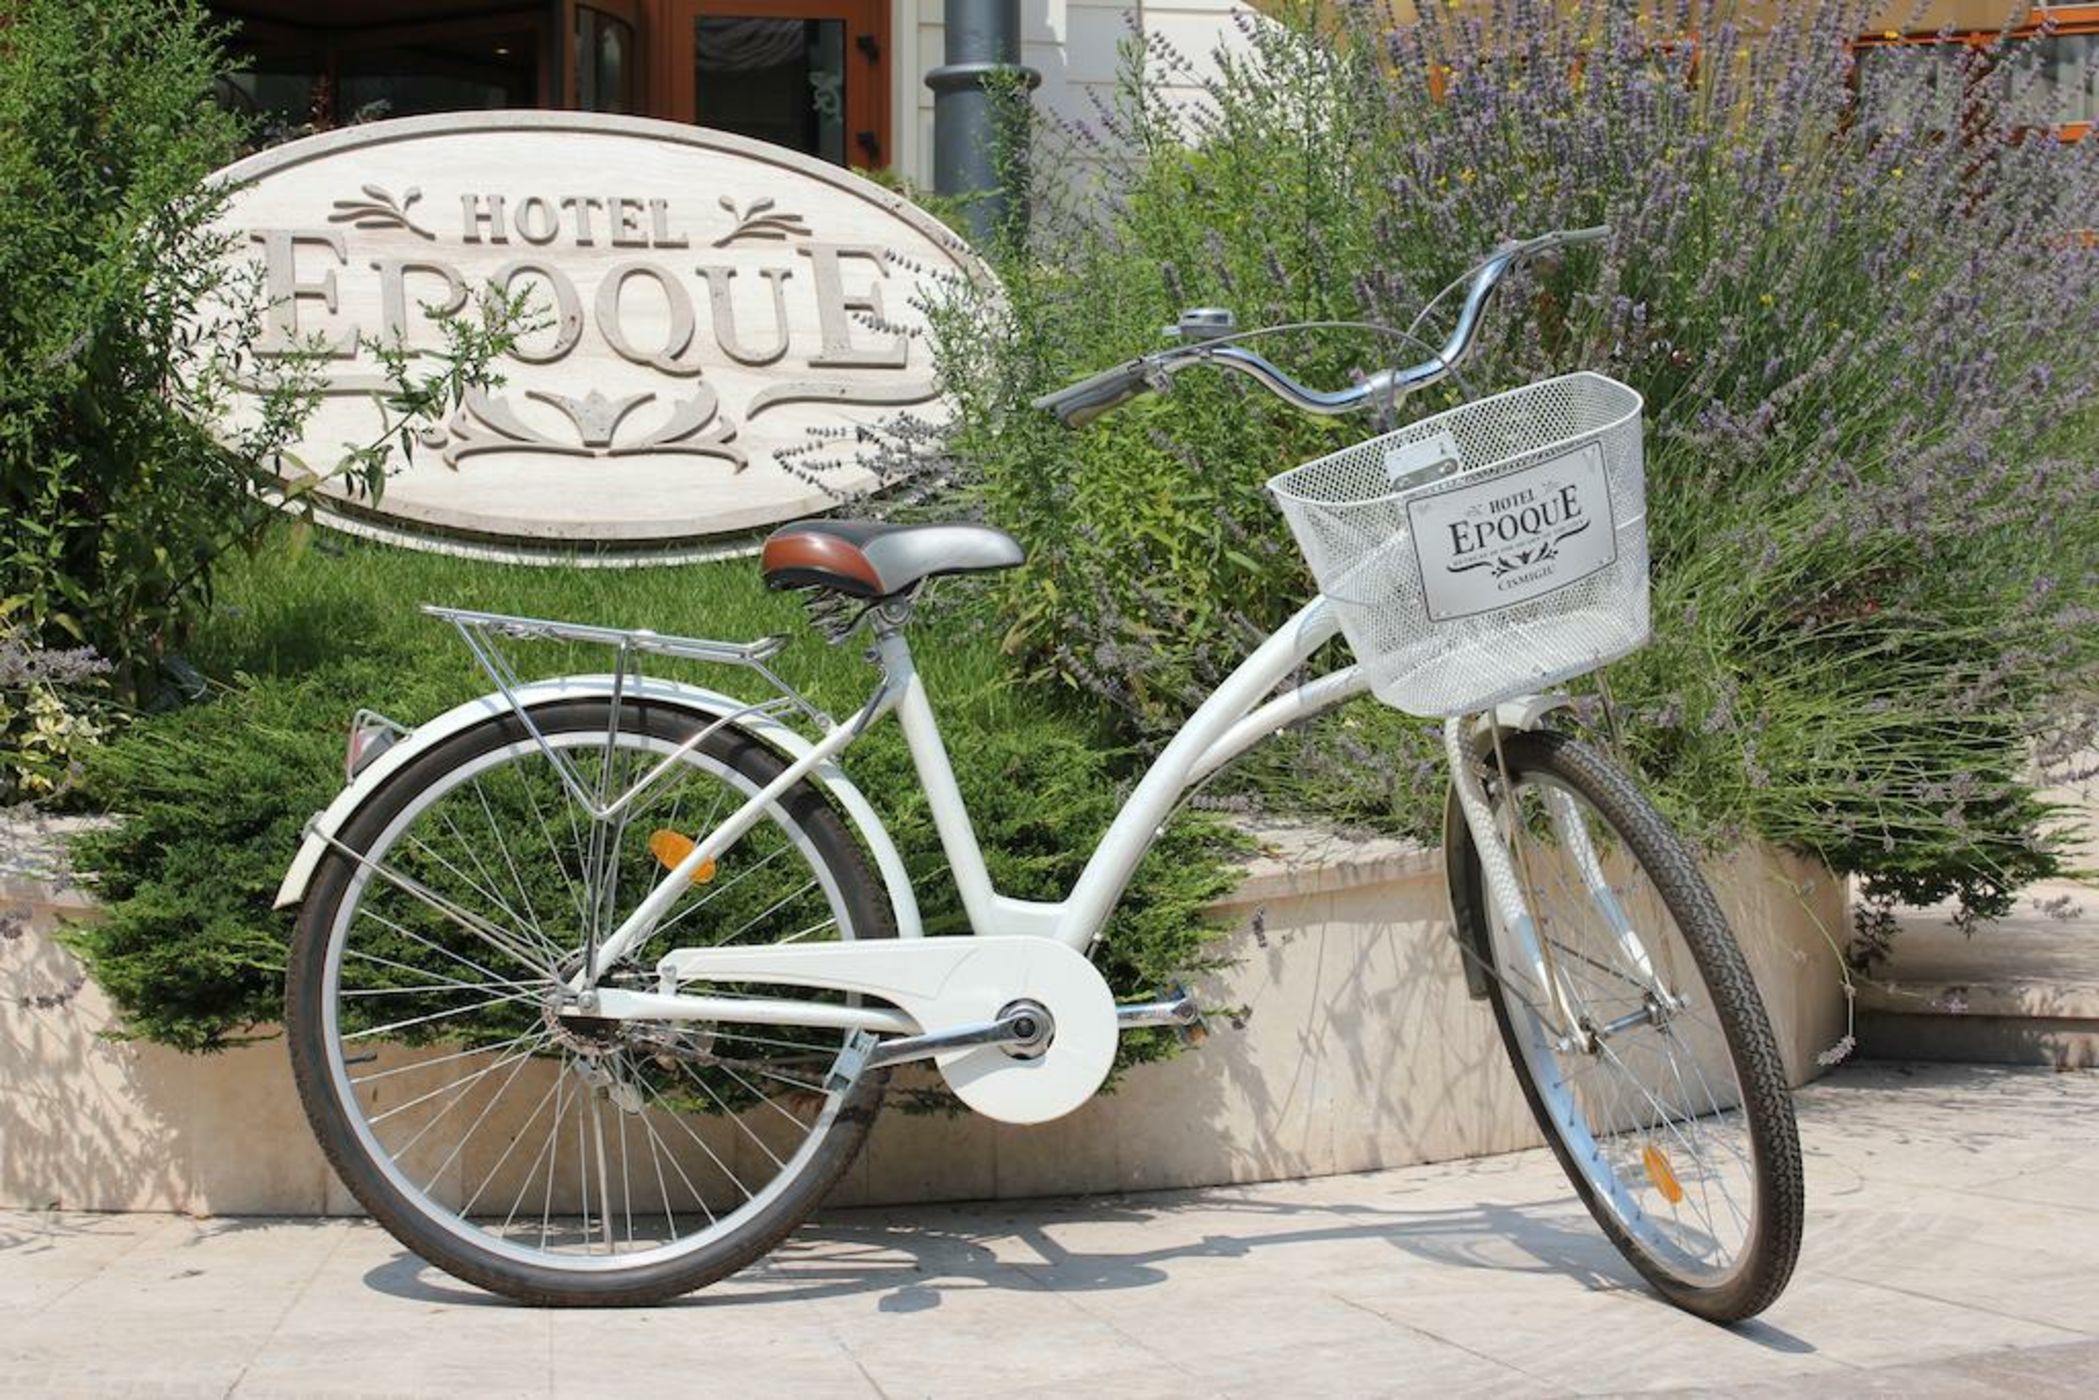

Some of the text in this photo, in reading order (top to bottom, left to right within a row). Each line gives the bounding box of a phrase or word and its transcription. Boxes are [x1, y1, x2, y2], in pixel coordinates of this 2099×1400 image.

[461, 194, 689, 249] HOTEL
[249, 229, 908, 377] EPOQUE
[1449, 485, 1582, 556] EPOQUE
[1489, 488, 1535, 514] HOTEL
